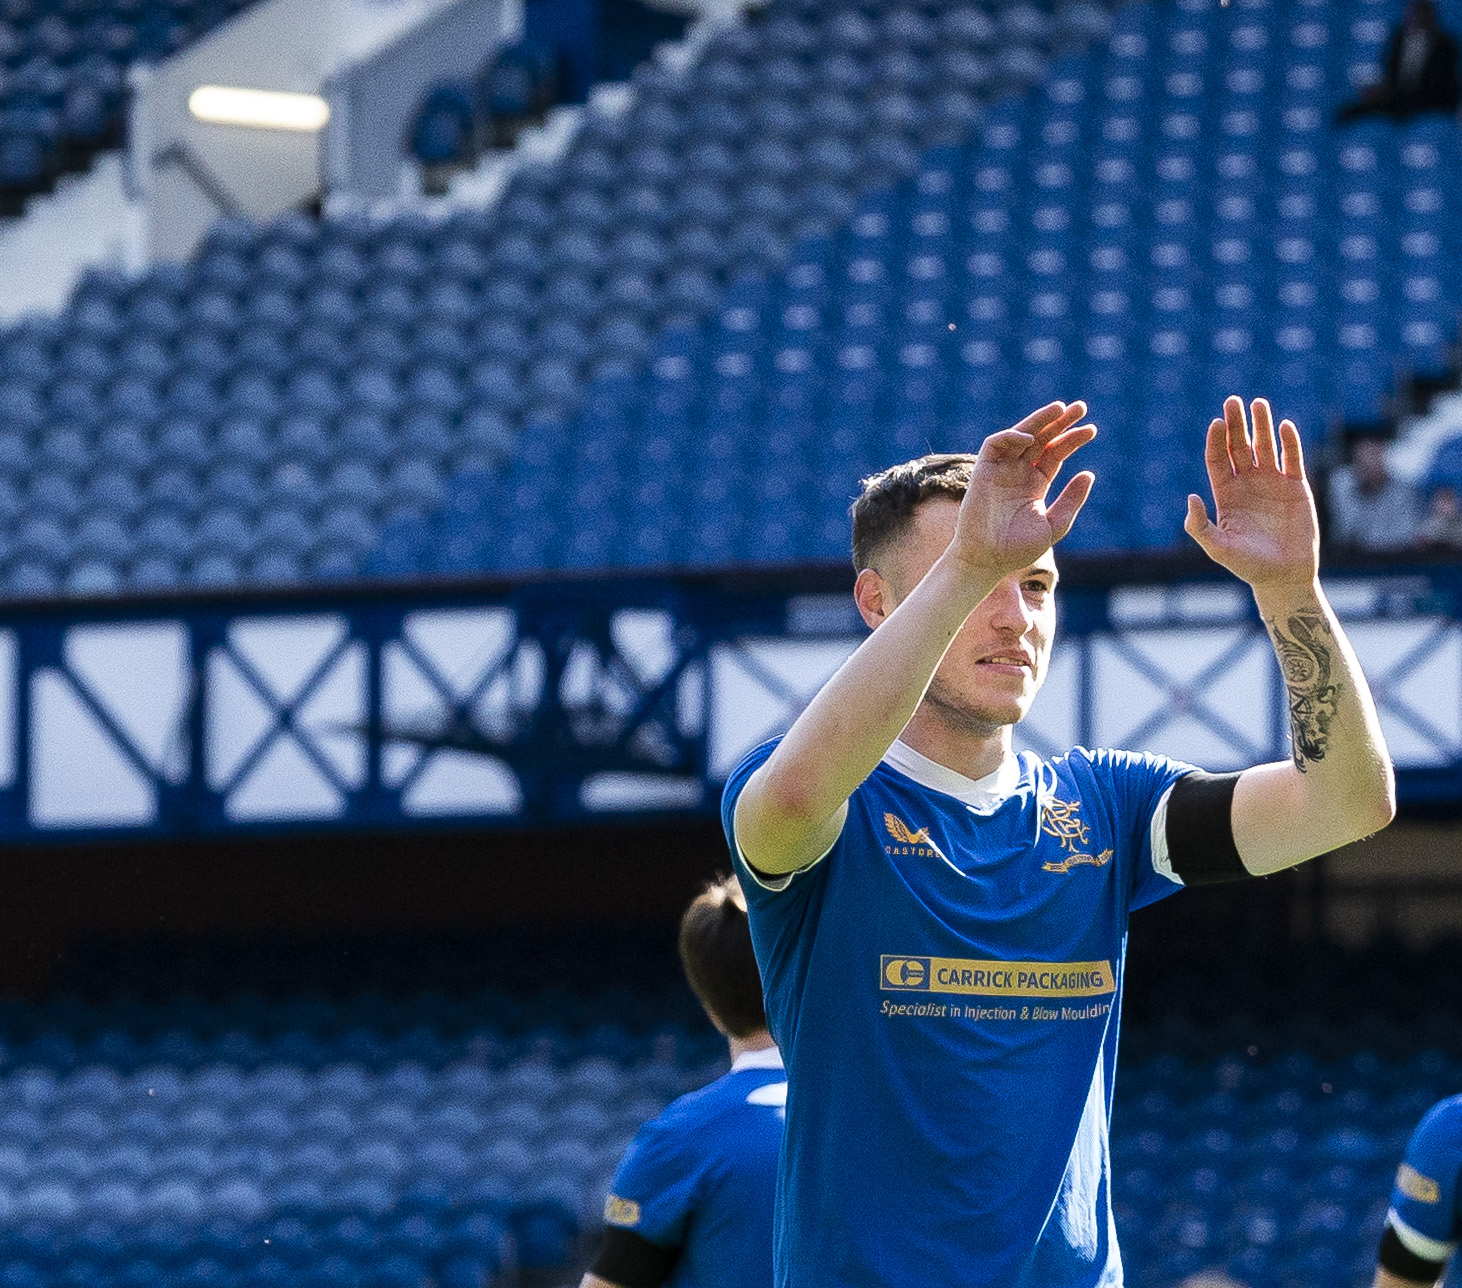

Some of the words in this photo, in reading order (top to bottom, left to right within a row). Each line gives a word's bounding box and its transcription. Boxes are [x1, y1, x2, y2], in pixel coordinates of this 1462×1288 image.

[937, 968, 1012, 988] CARRICK
[1018, 971, 1104, 989] PACKAGING
[880, 1000, 947, 1018] Specialist
[950, 1004, 960, 1017] in
[964, 1004, 1016, 1021] Injection
[1020, 1006, 1029, 1020] &
[1032, 1007, 1058, 1020] Blow
[1061, 1003, 1110, 1020] Mouldin
